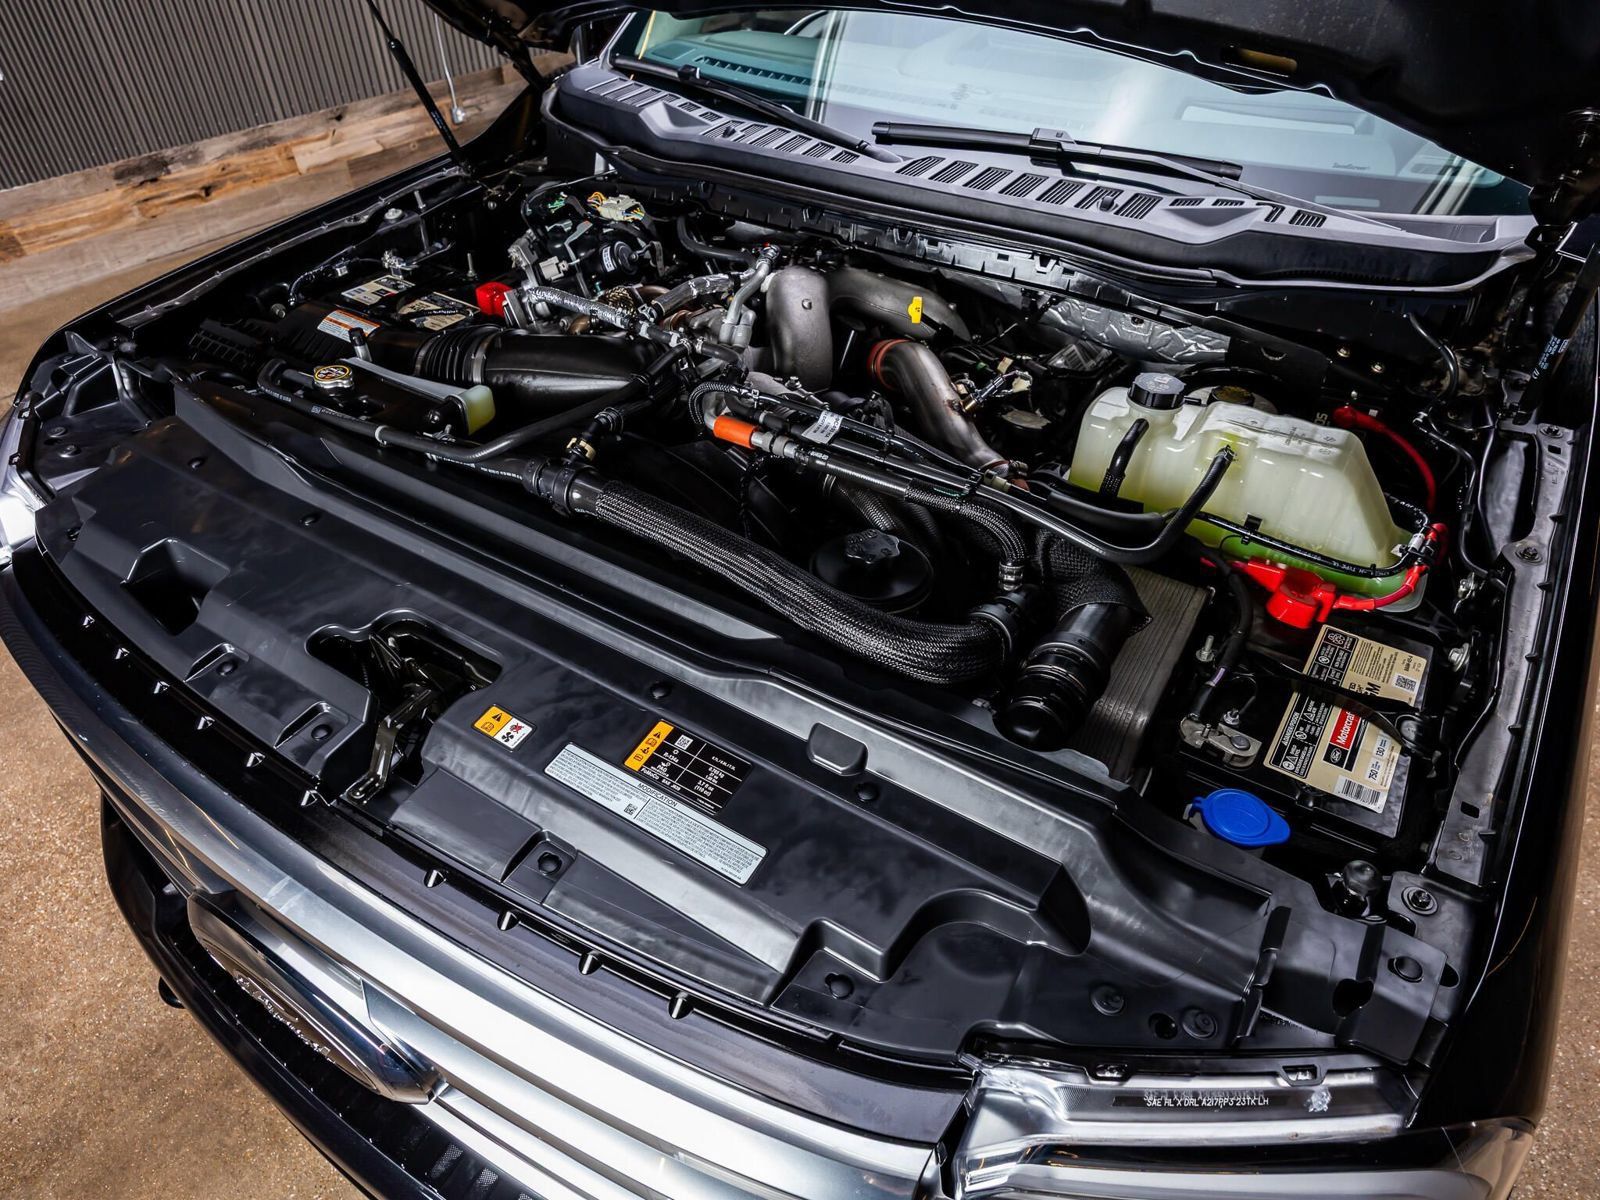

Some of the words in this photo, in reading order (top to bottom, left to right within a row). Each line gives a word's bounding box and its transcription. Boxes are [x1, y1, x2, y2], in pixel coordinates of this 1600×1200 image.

[1336, 711, 1356, 745] Motorcraf
[637, 782, 678, 807] MODIFICATION
[1146, 1098, 1163, 1107] SAE
[1163, 1098, 1175, 1107] HL
[1176, 1098, 1183, 1106] X
[1183, 1098, 1200, 1107] DRL
[1235, 1098, 1257, 1107] 23TK
[1258, 1097, 1270, 1106] LH
